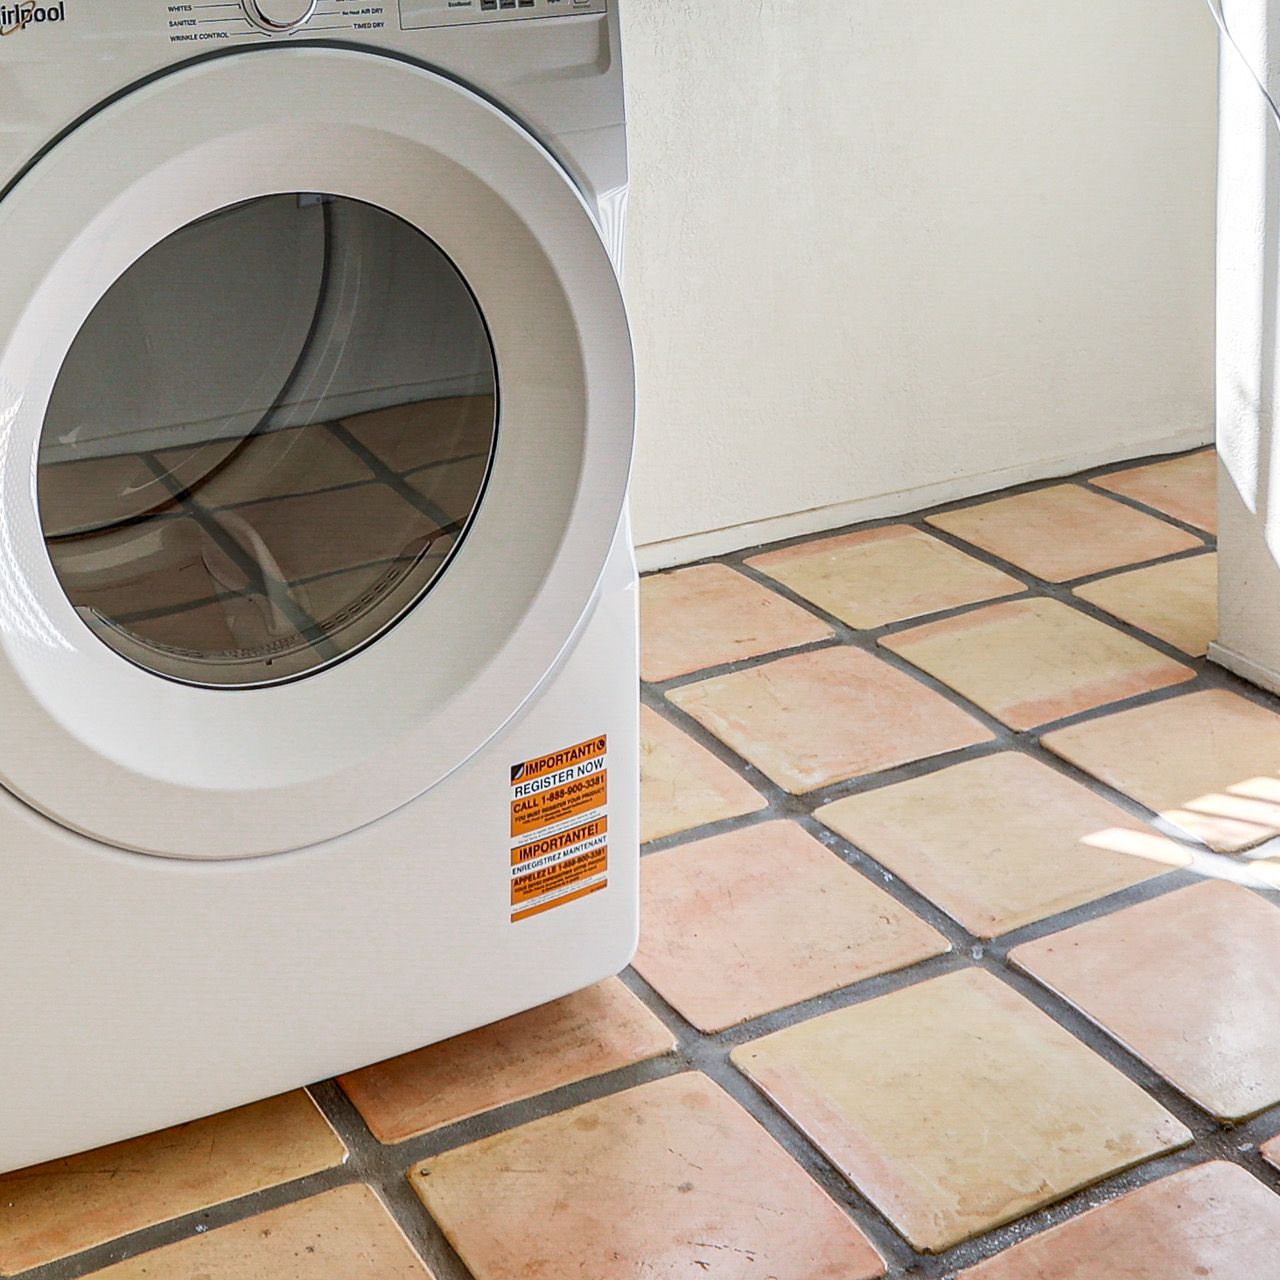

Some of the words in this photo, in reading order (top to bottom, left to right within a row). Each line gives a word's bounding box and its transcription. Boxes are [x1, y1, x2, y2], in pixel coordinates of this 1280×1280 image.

[169, 19, 196, 27] SANITIZE
[515, 768, 574, 798] REGISTER
[577, 757, 604, 776] NOW
[525, 742, 595, 776] IMPORTANT!
[513, 798, 539, 813] CALL
[541, 775, 604, 804] 1-888-900-3381
[512, 852, 561, 875] ENREGISTREZ
[563, 835, 607, 857] MAINTENANT
[519, 823, 598, 860] IMPORTANTE!
[513, 870, 546, 887] APPELEZ
[548, 865, 557, 873] LE
